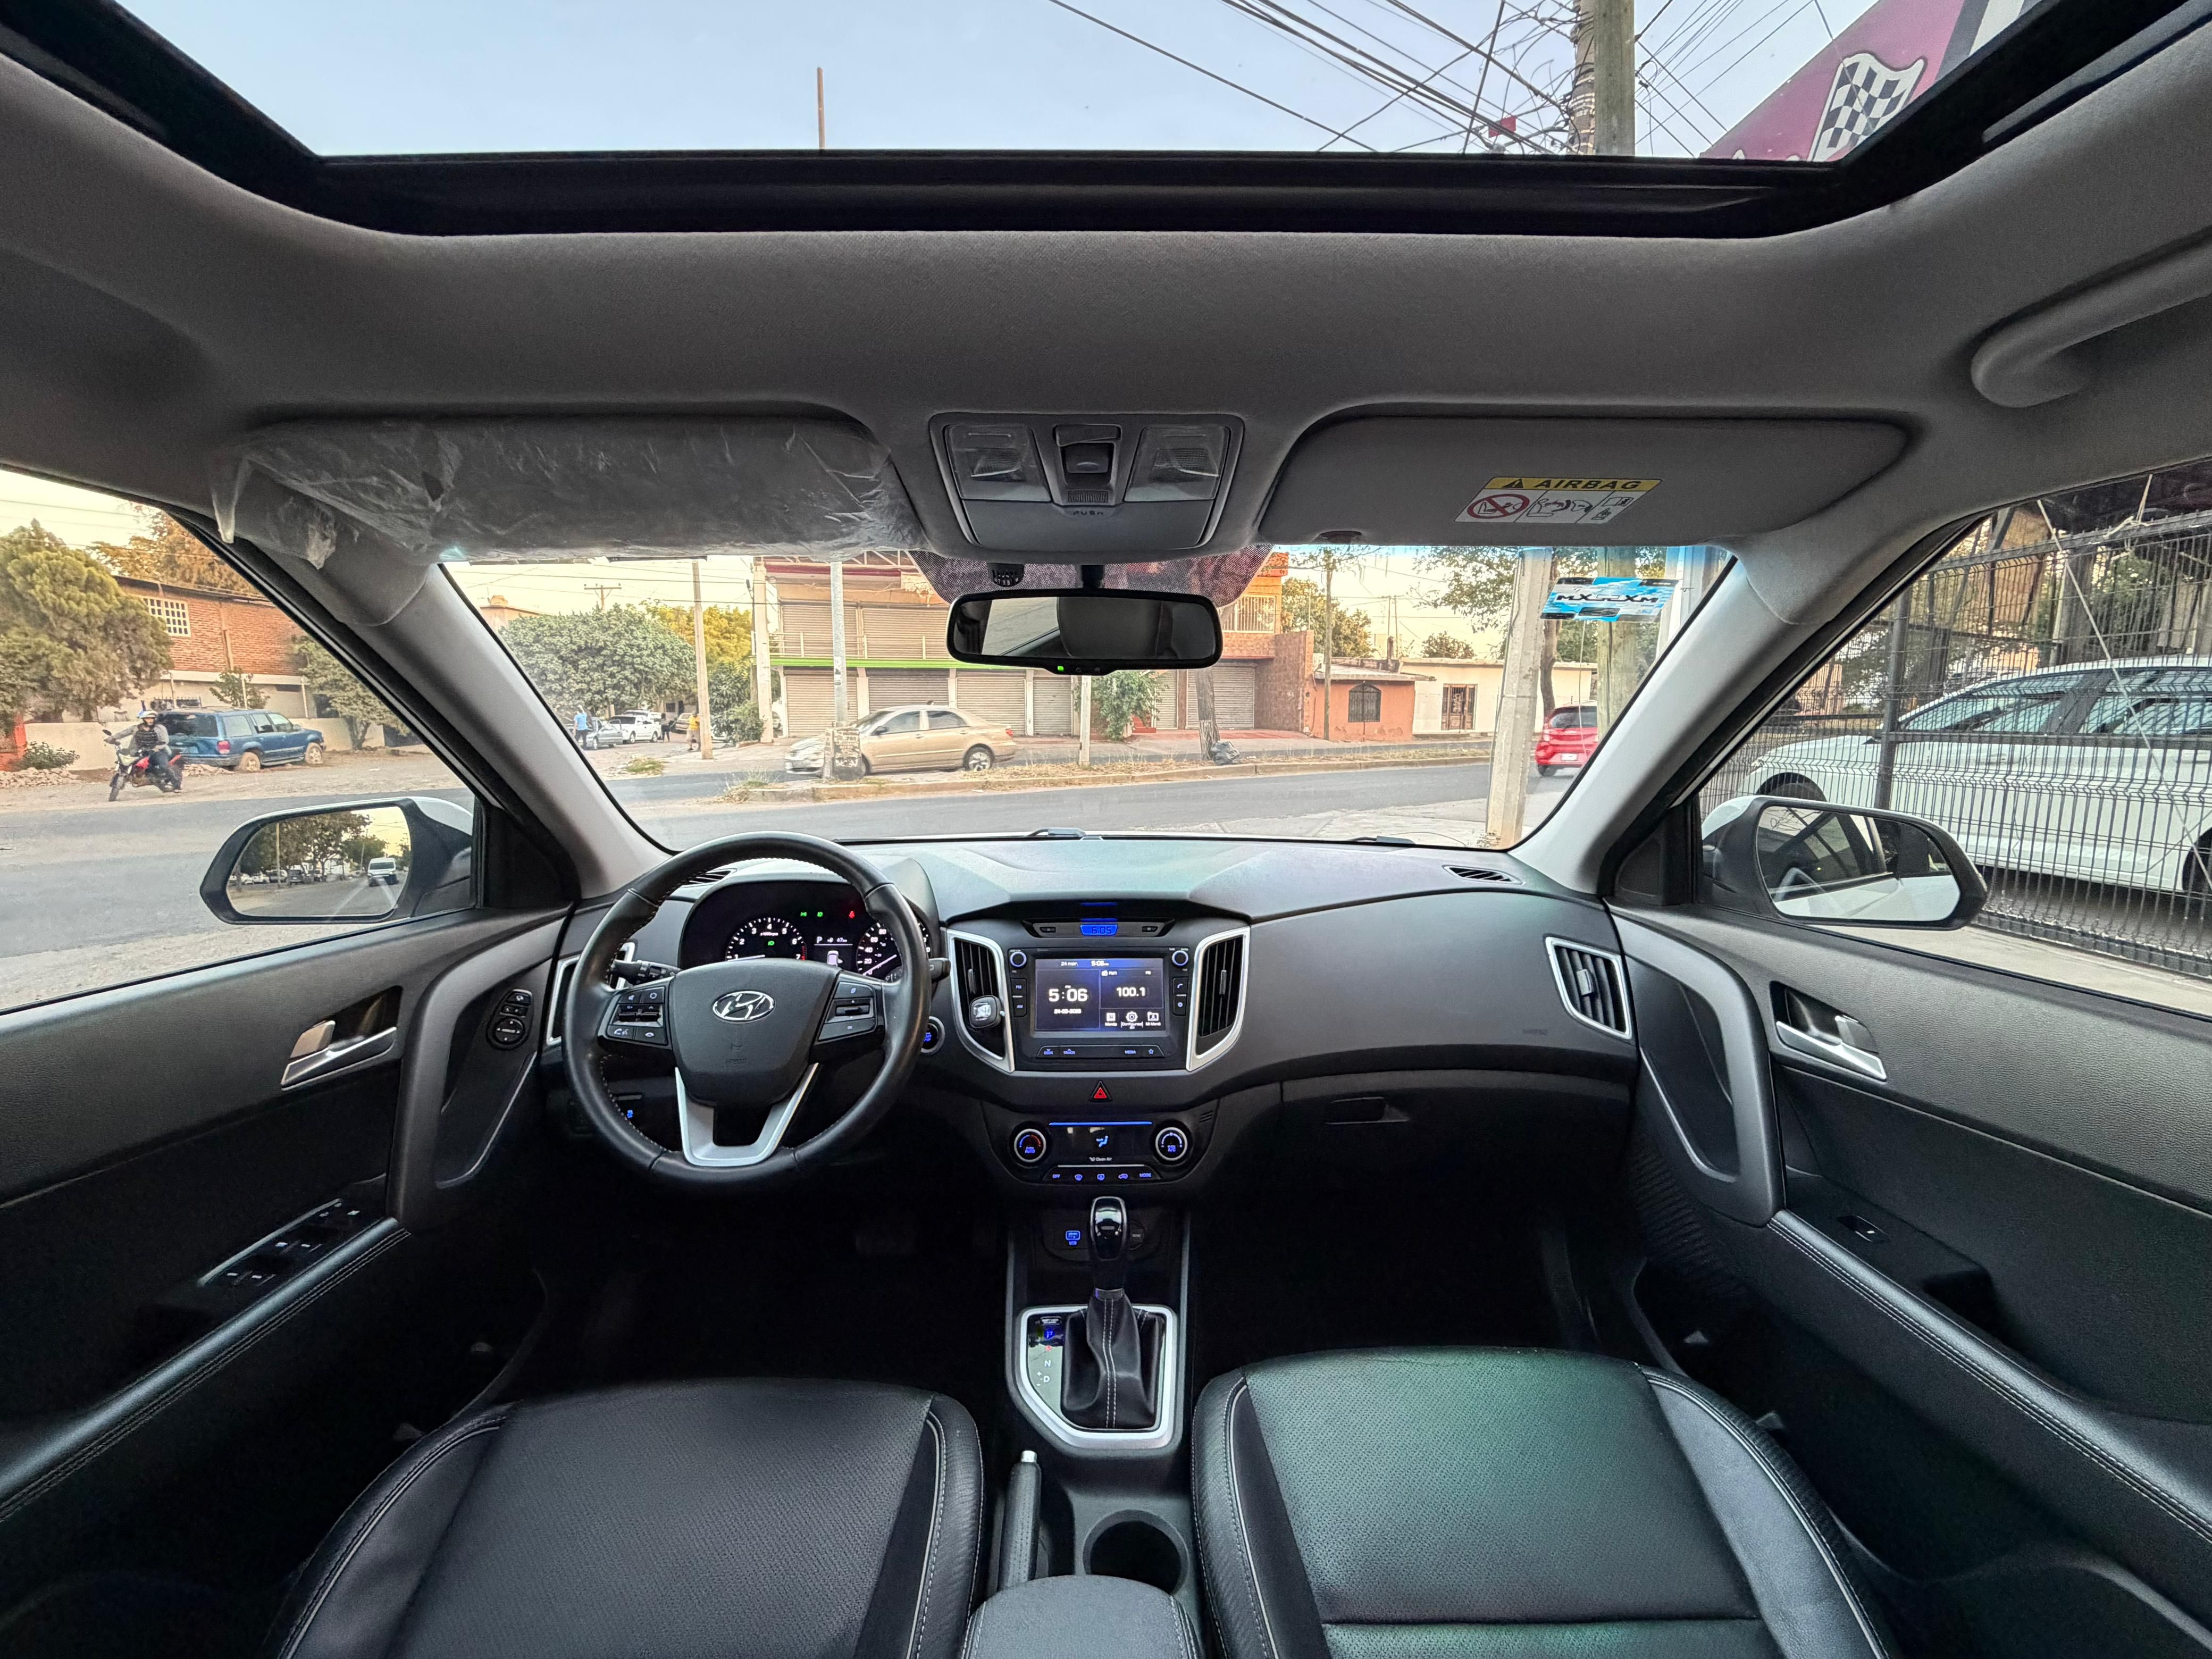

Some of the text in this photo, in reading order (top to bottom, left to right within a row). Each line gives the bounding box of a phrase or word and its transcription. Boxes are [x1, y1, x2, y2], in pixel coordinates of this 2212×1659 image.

[1534, 480, 1641, 489] AIRBAG
[1048, 988, 1088, 1002] 5:06
[1116, 987, 1146, 997] 100.1
[1044, 1359, 1051, 1368] N
